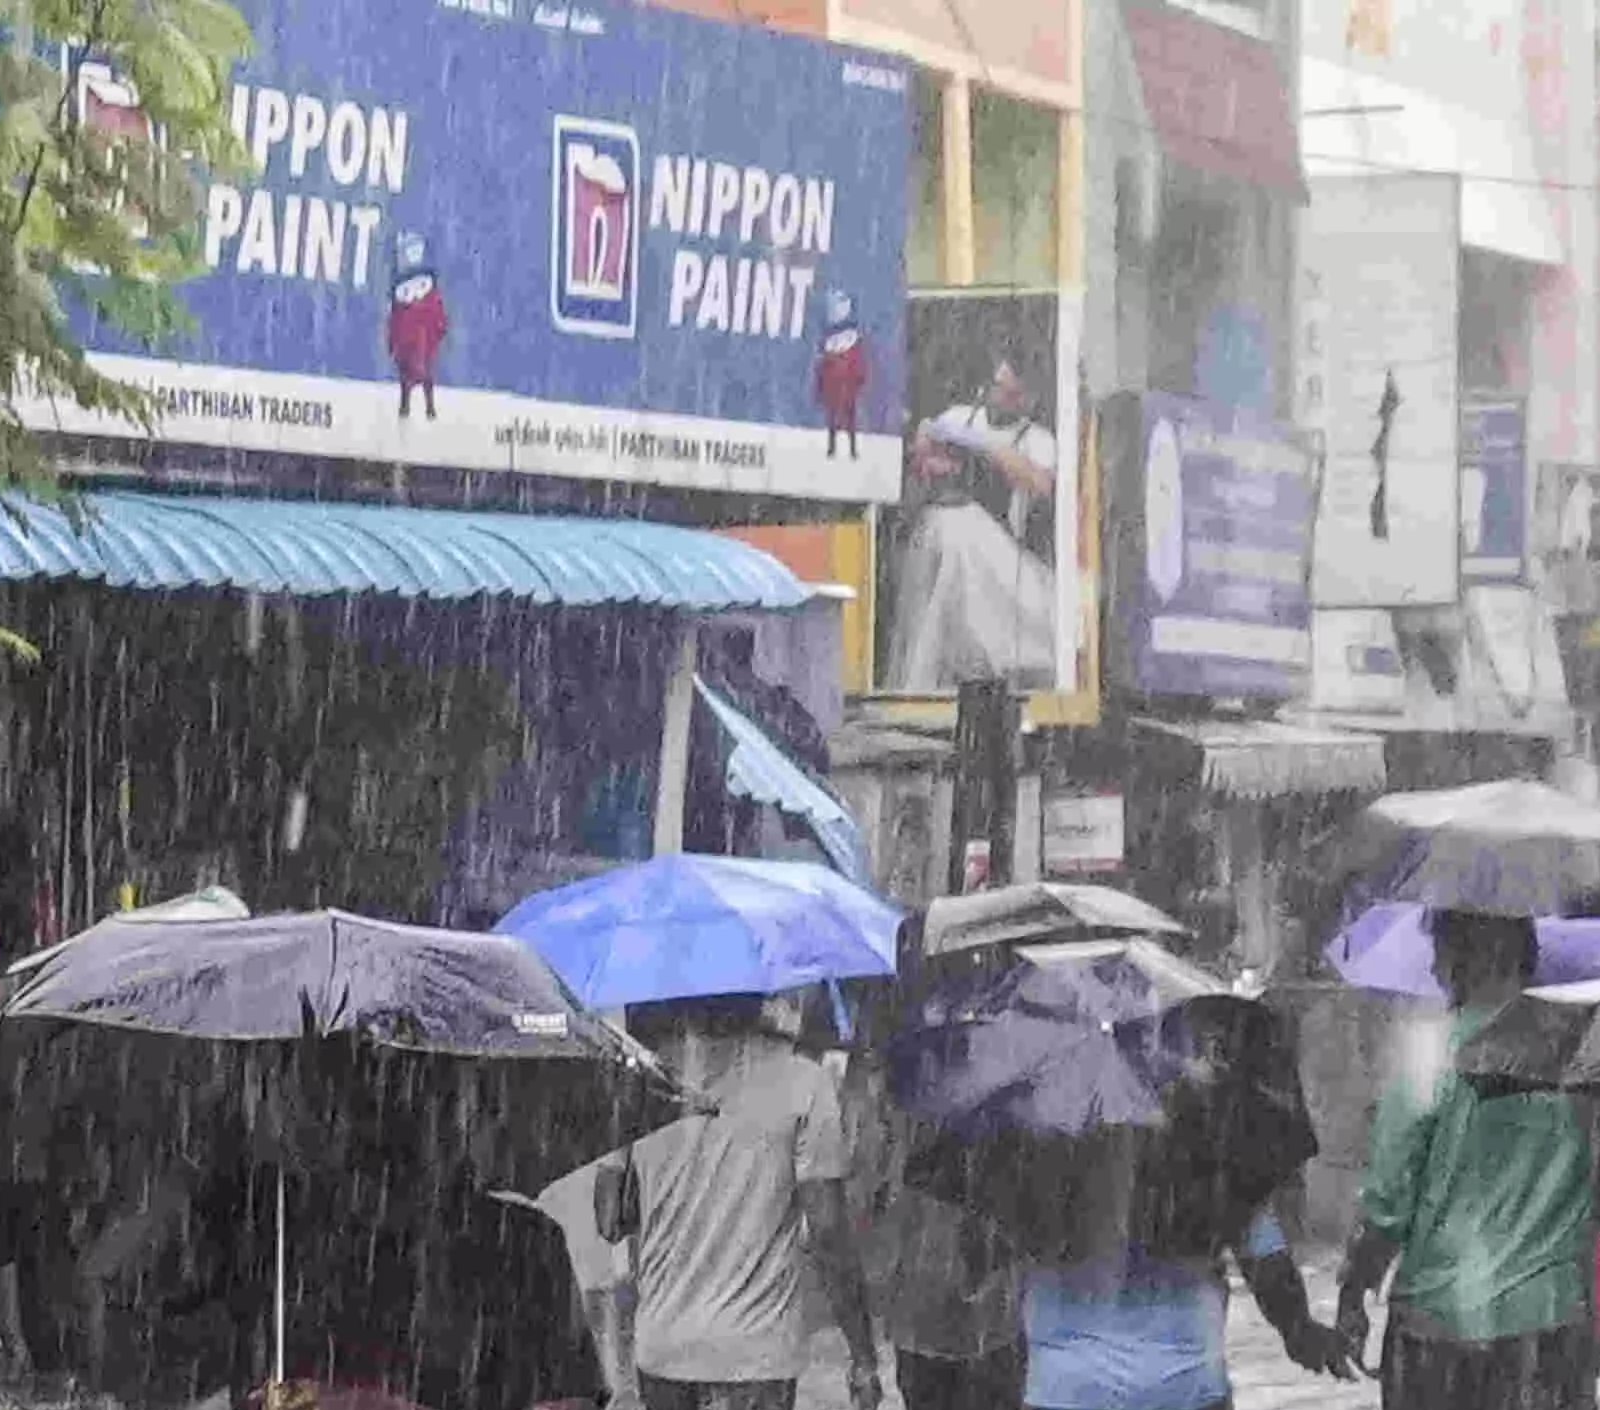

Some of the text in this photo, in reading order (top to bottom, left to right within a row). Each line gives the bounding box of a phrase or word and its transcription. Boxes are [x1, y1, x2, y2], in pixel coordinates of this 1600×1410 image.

[231, 83, 407, 193] IPPON
[204, 183, 380, 287] PAINT
[650, 154, 834, 253] NIPPON
[668, 249, 815, 338] PAINT
[157, 386, 332, 429] PARTHIBAN TRADERS
[706, 438, 766, 468] TRADERS
